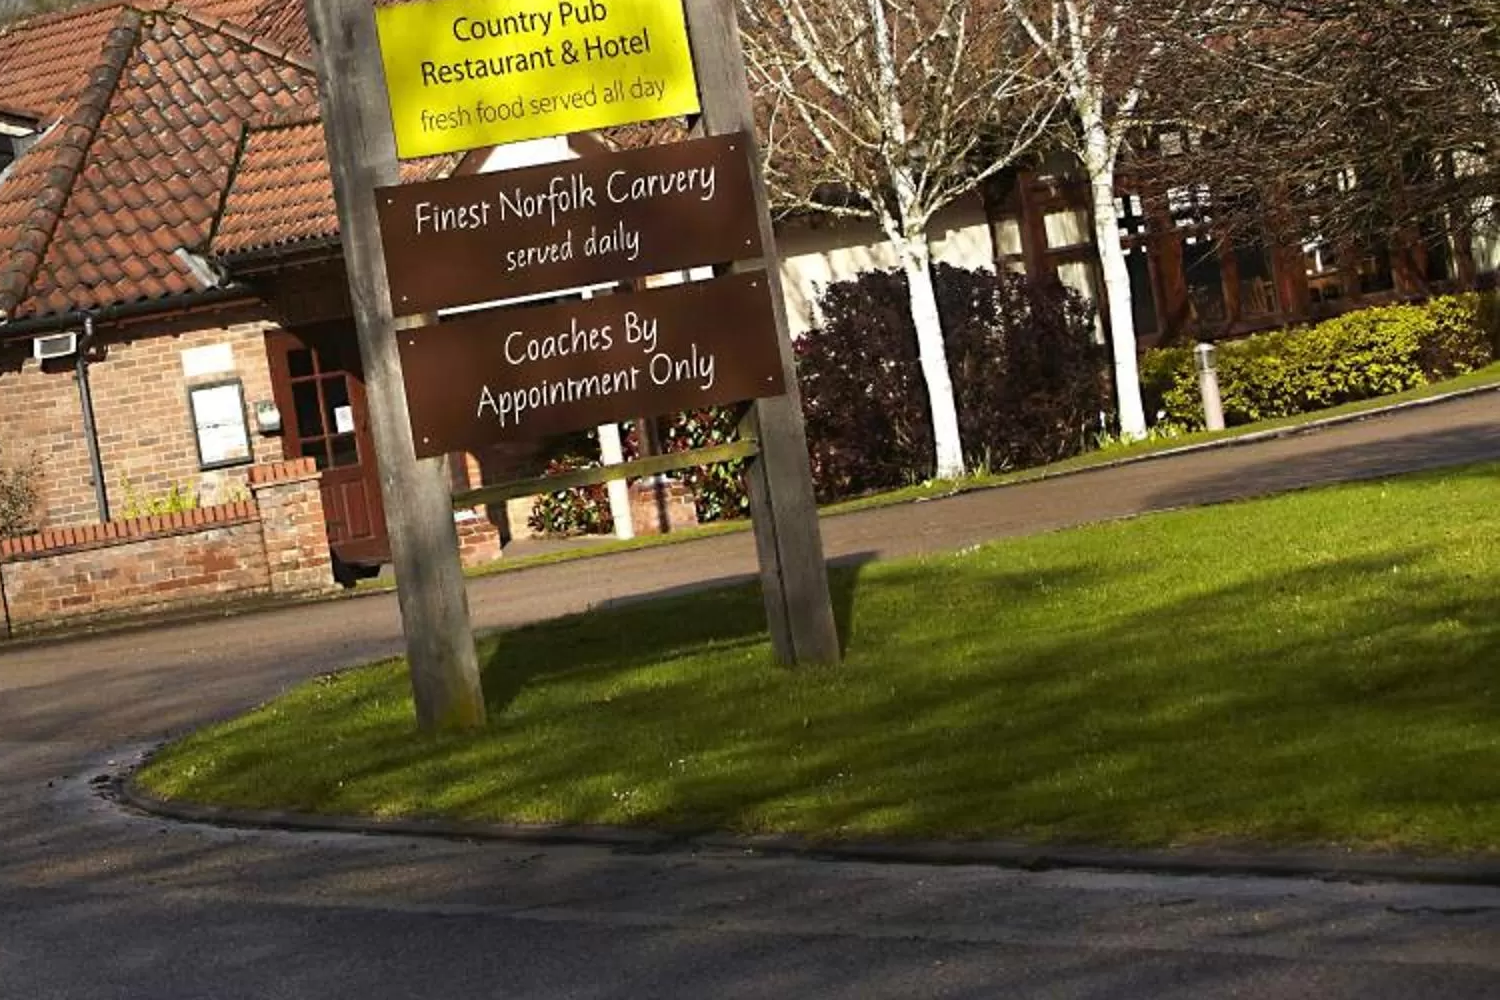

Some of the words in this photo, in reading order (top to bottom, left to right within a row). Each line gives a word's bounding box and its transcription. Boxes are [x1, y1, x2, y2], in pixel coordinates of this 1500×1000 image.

[453, 10, 552, 42] Country
[420, 45, 556, 87] Restaurant
[561, 39, 579, 65] &
[584, 28, 651, 61] Hotel
[420, 108, 472, 133] fresh
[475, 98, 525, 126] food
[530, 86, 597, 113] served
[603, 80, 625, 105] all
[631, 76, 666, 102] day
[415, 200, 491, 235] Finest
[499, 173, 597, 226] Norfolk
[607, 165, 716, 203] Carvery
[506, 230, 573, 271] served
[584, 221, 640, 261] daily
[504, 317, 613, 365] Coaches
[624, 311, 657, 353] By
[477, 366, 641, 427] Appointment
[649, 343, 715, 390] Only
